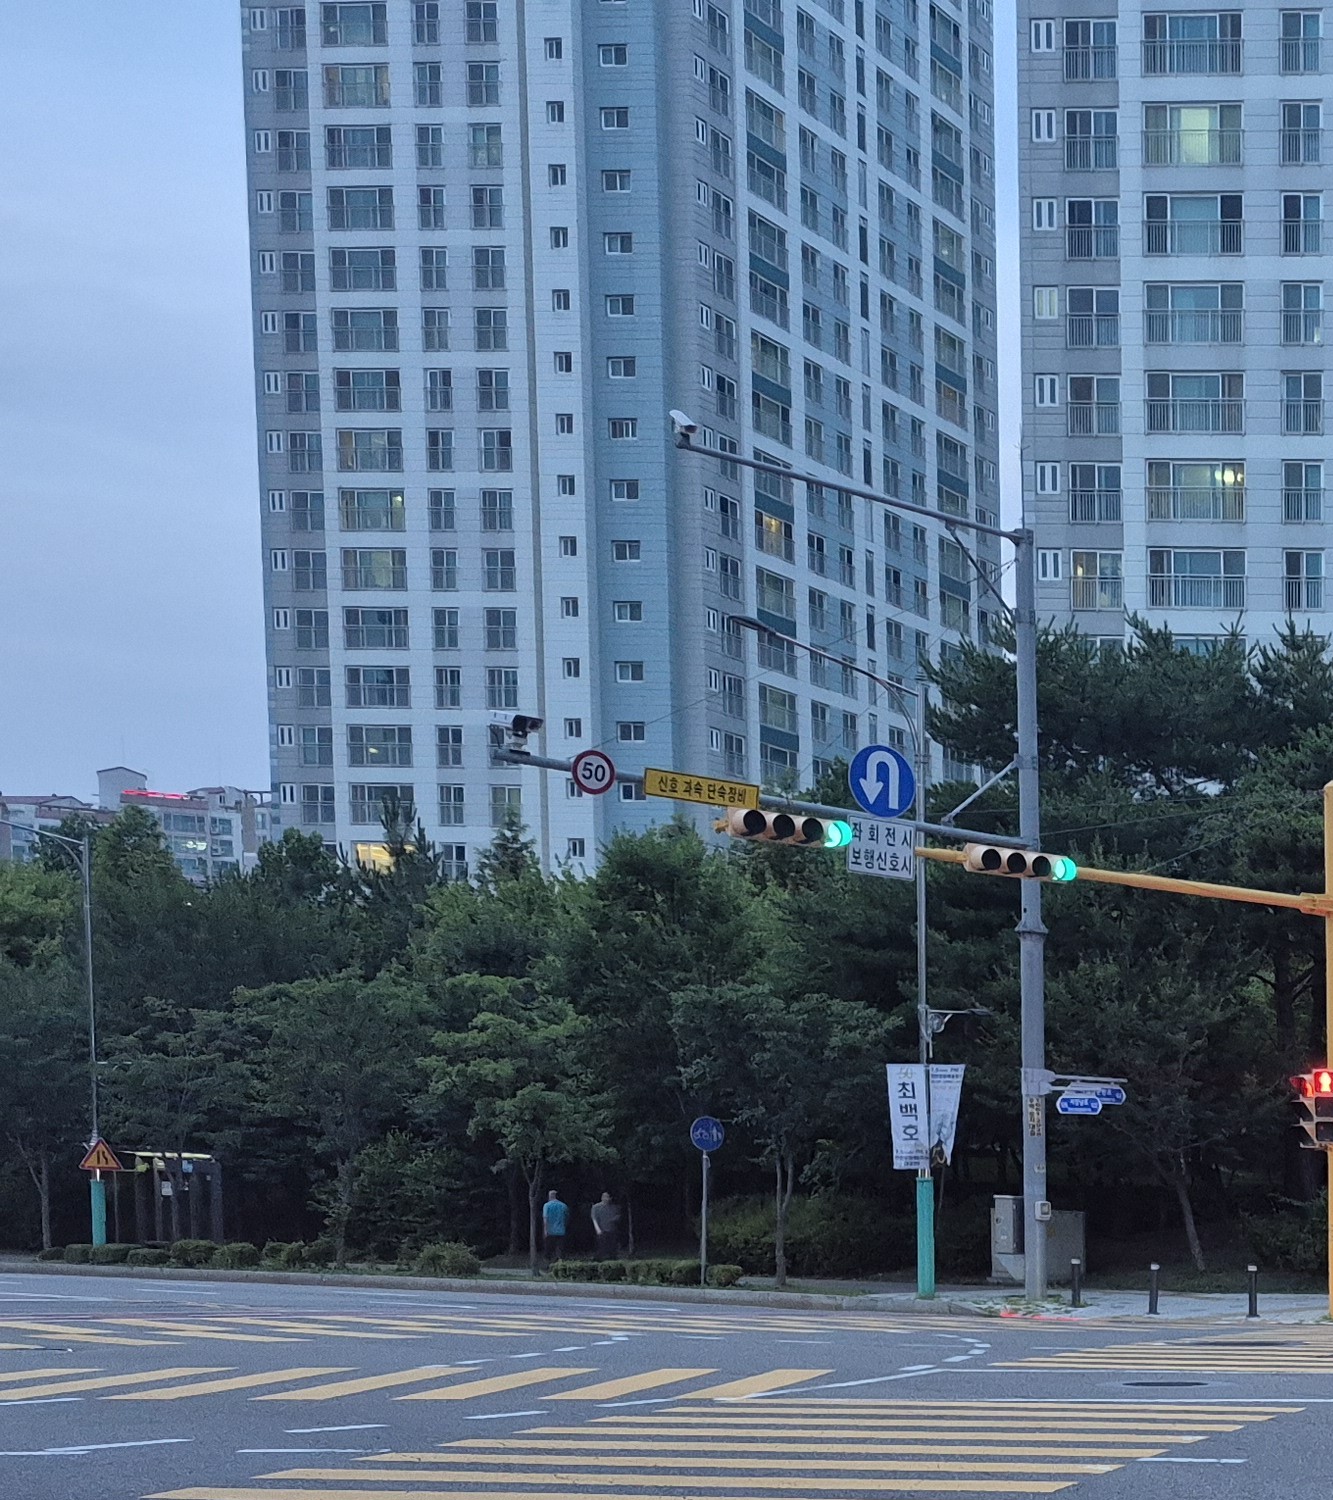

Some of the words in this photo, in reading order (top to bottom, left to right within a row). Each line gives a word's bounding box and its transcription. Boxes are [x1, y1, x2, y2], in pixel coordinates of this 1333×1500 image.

[581, 761, 606, 782] 50
[658, 775, 679, 794] 신호
[682, 780, 703, 798] 과속
[707, 784, 747, 804] 단속장비
[850, 847, 912, 876] 보행신호시
[898, 1081, 919, 1141] 최백호
